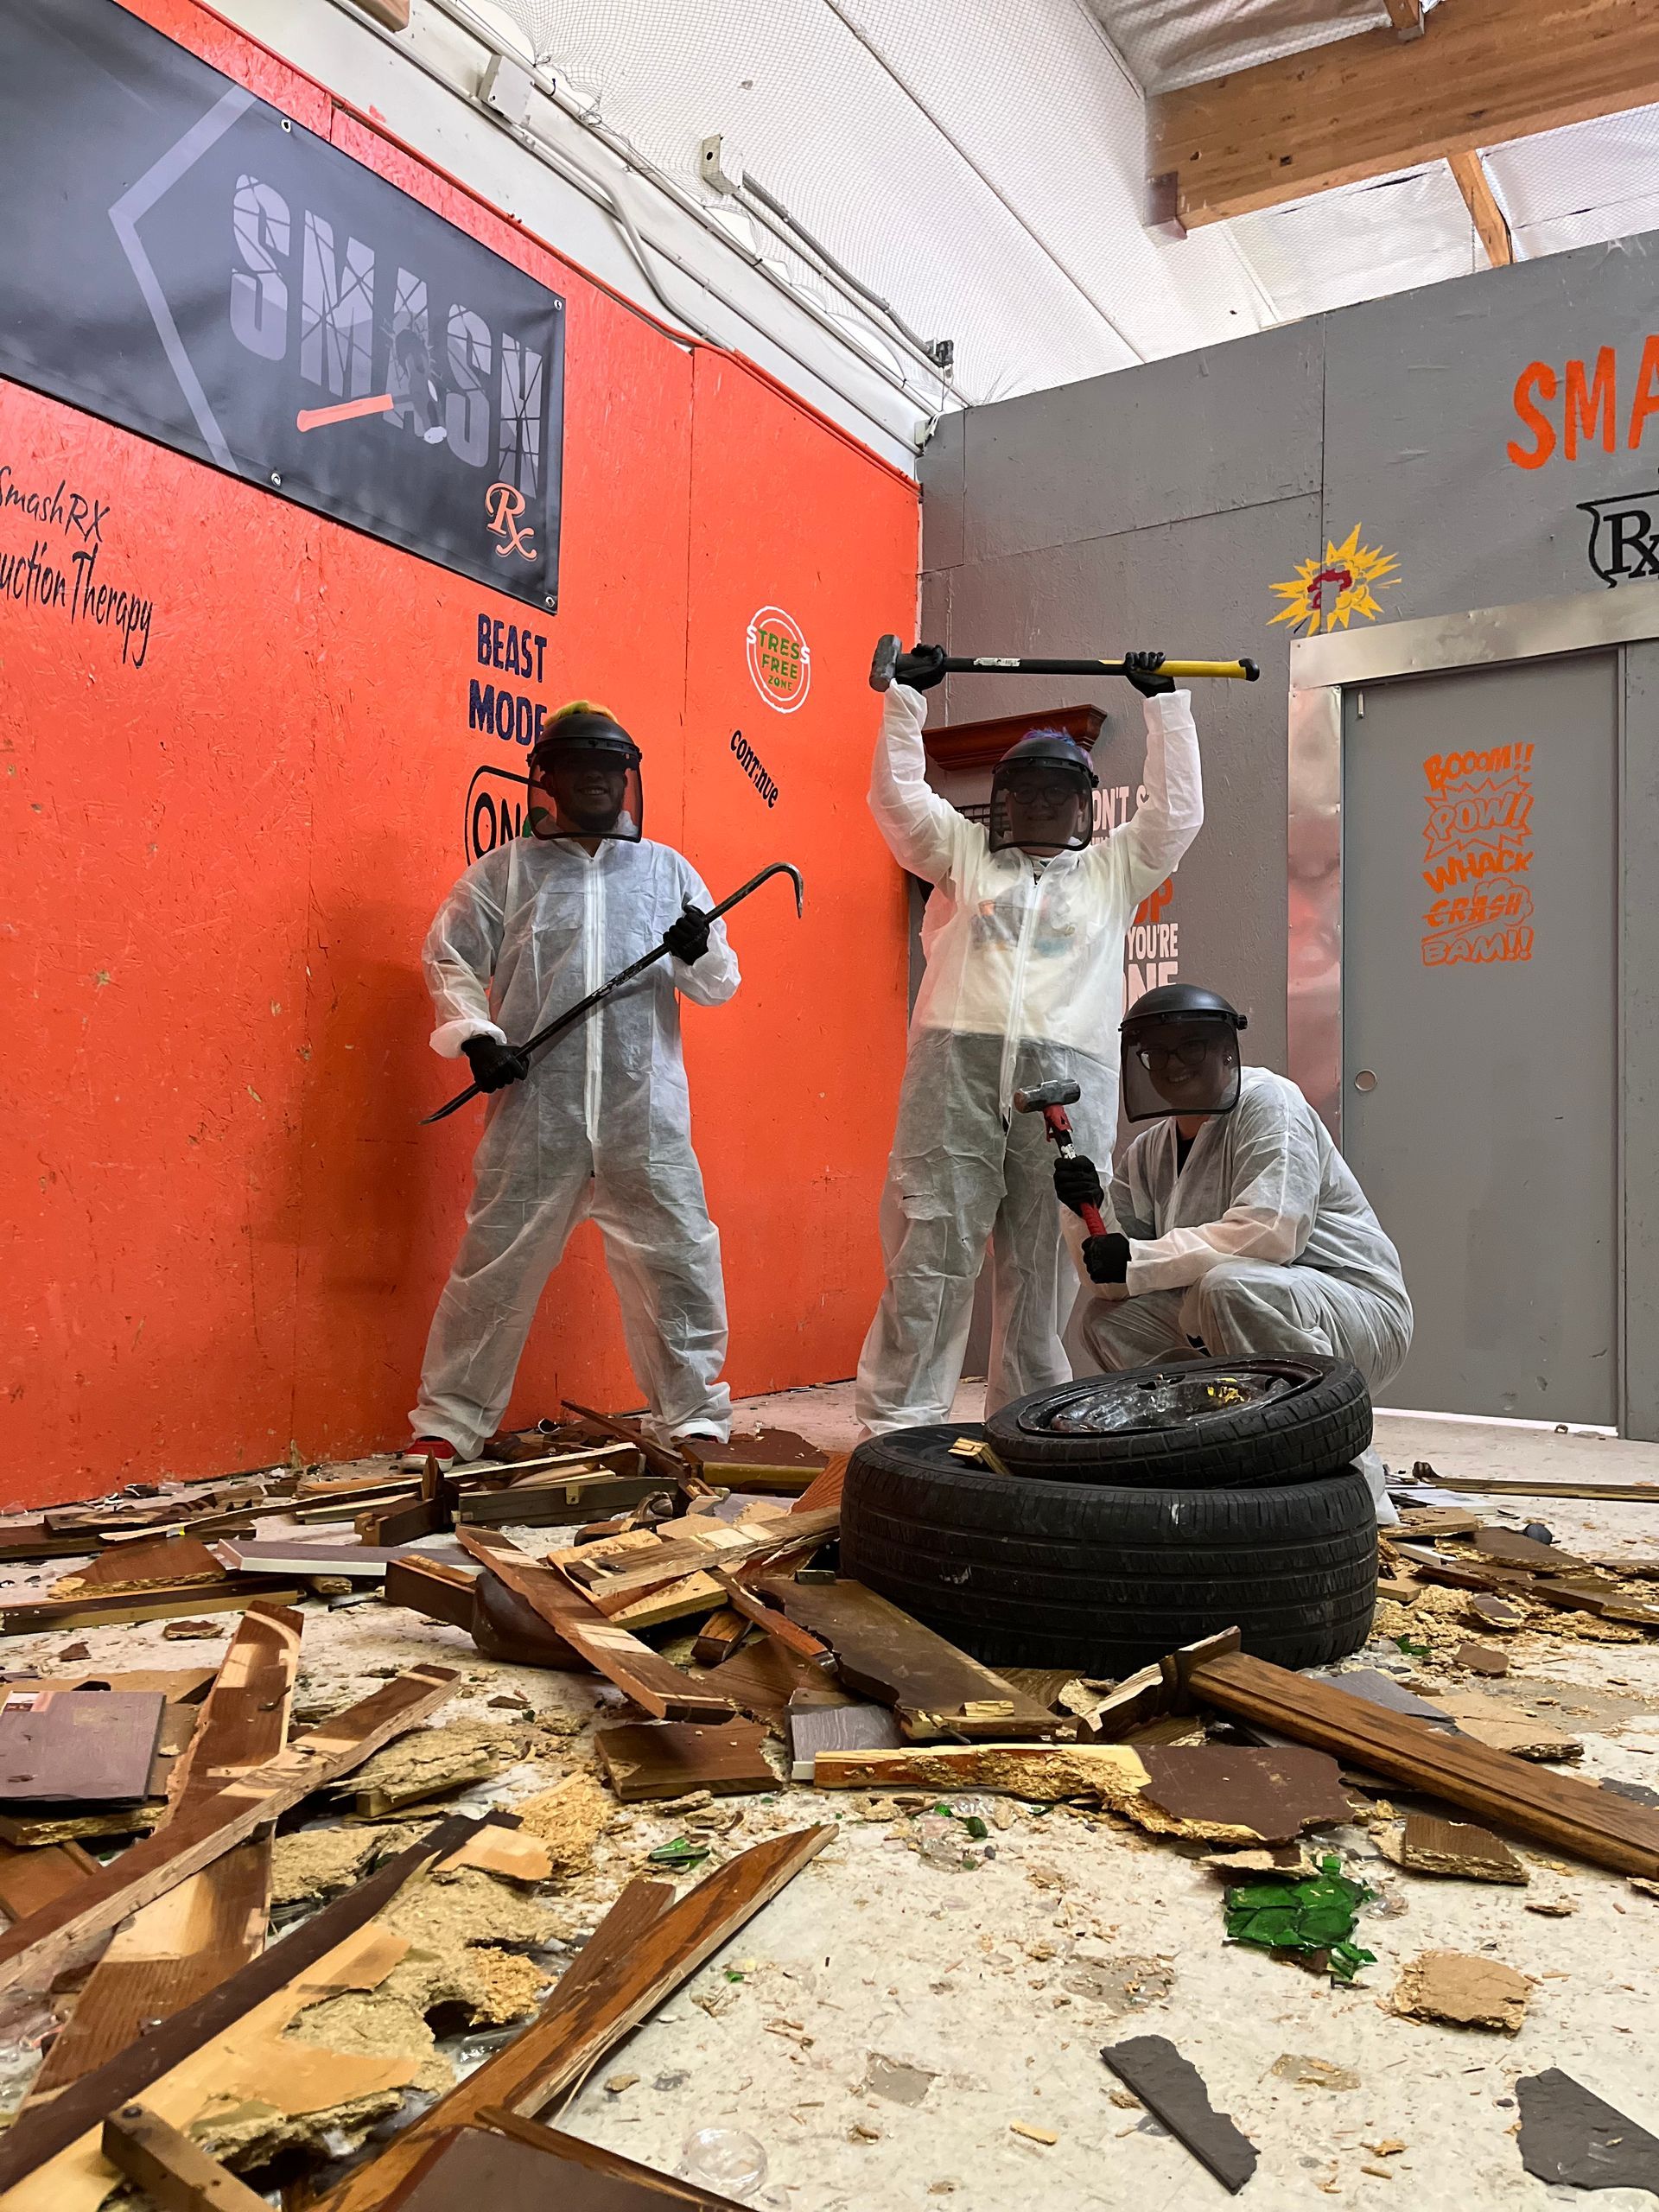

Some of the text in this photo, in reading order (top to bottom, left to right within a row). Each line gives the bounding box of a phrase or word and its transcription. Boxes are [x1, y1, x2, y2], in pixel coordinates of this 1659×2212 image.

[230, 174, 543, 499] SMASH
[1507, 334, 1659, 470] SMA
[0, 465, 66, 524] Smash
[0, 539, 153, 669] uction Therapy
[478, 613, 547, 683] BEAST
[746, 625, 810, 664] STRESS
[761, 653, 798, 680] FREE
[767, 675, 793, 691] ZONE
[469, 678, 547, 747] MODE
[1430, 791, 1535, 842] POW!
[1423, 849, 1534, 895] WHACK
[1423, 892, 1524, 928] CRASH
[1127, 923, 1179, 961] YOU'RE
[1421, 926, 1535, 967] BAM!!
